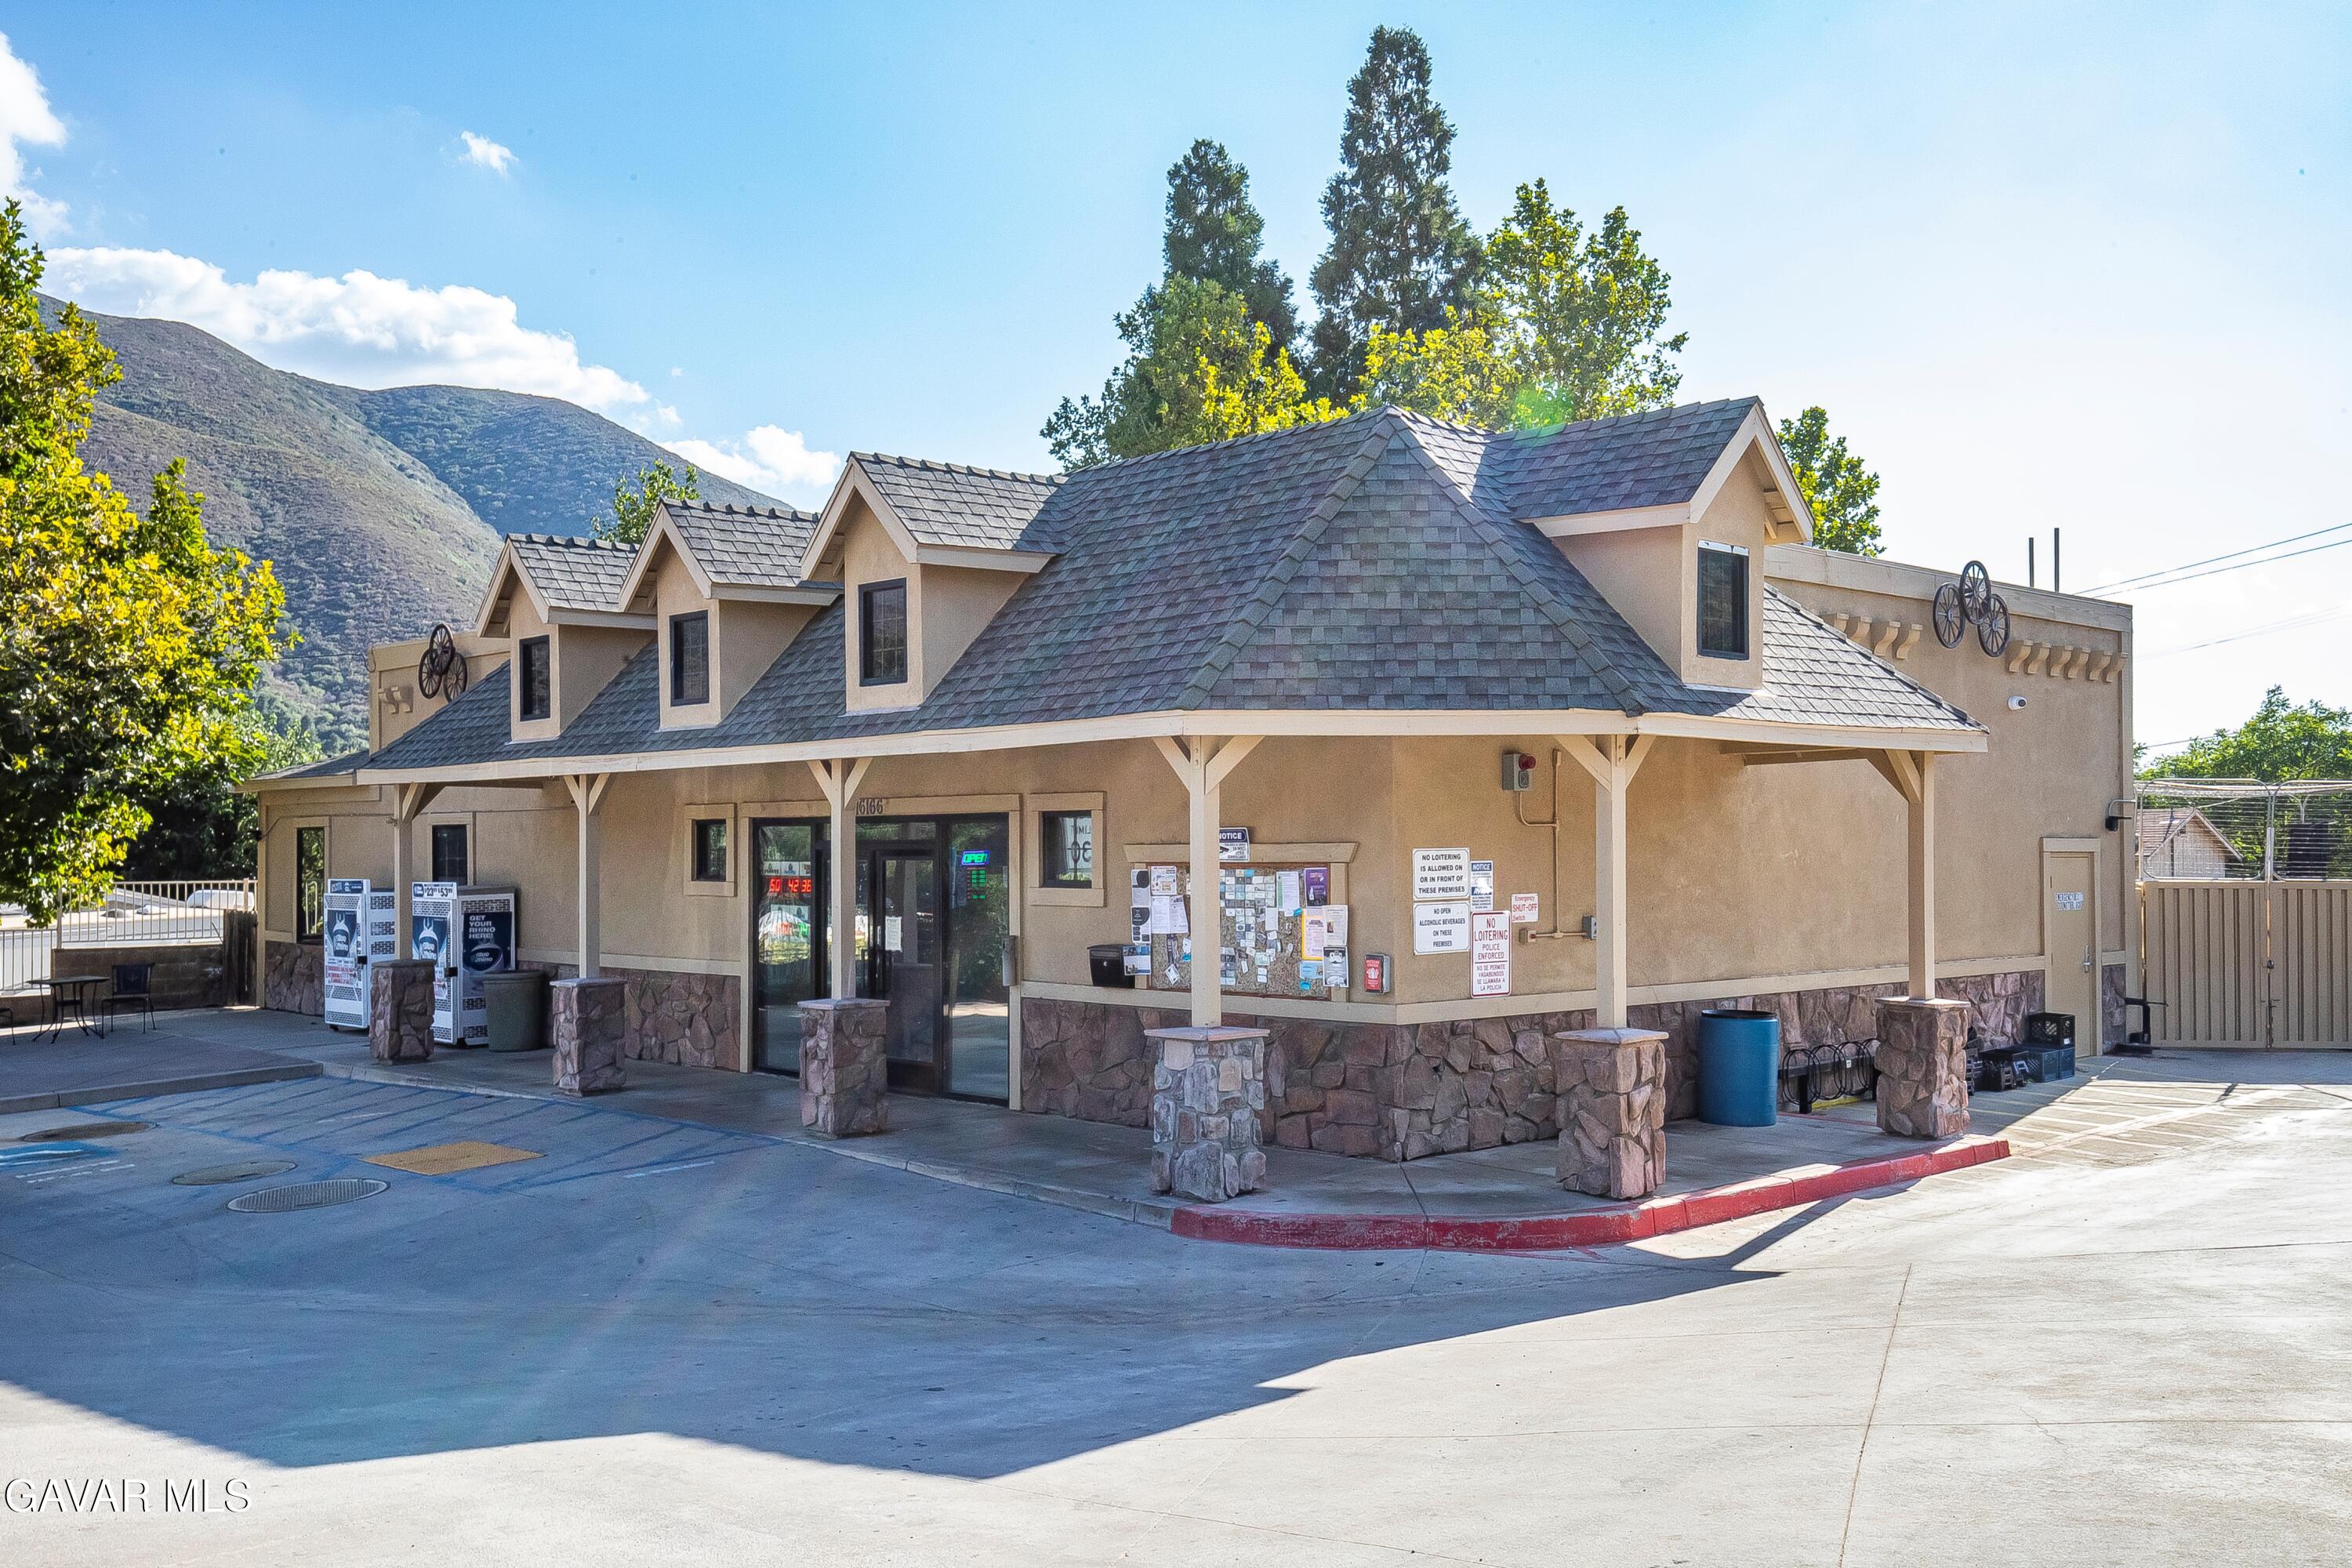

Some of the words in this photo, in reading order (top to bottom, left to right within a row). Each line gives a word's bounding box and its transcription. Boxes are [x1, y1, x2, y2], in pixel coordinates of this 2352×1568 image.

[855, 798, 884, 815] 16166
[964, 853, 988, 863] OPEN
[1512, 903, 1537, 913] SHUT-OFF
[1486, 917, 1496, 929] NO
[1474, 929, 1508, 942] LOITERING
[1478, 952, 1505, 960] ENFORCED
